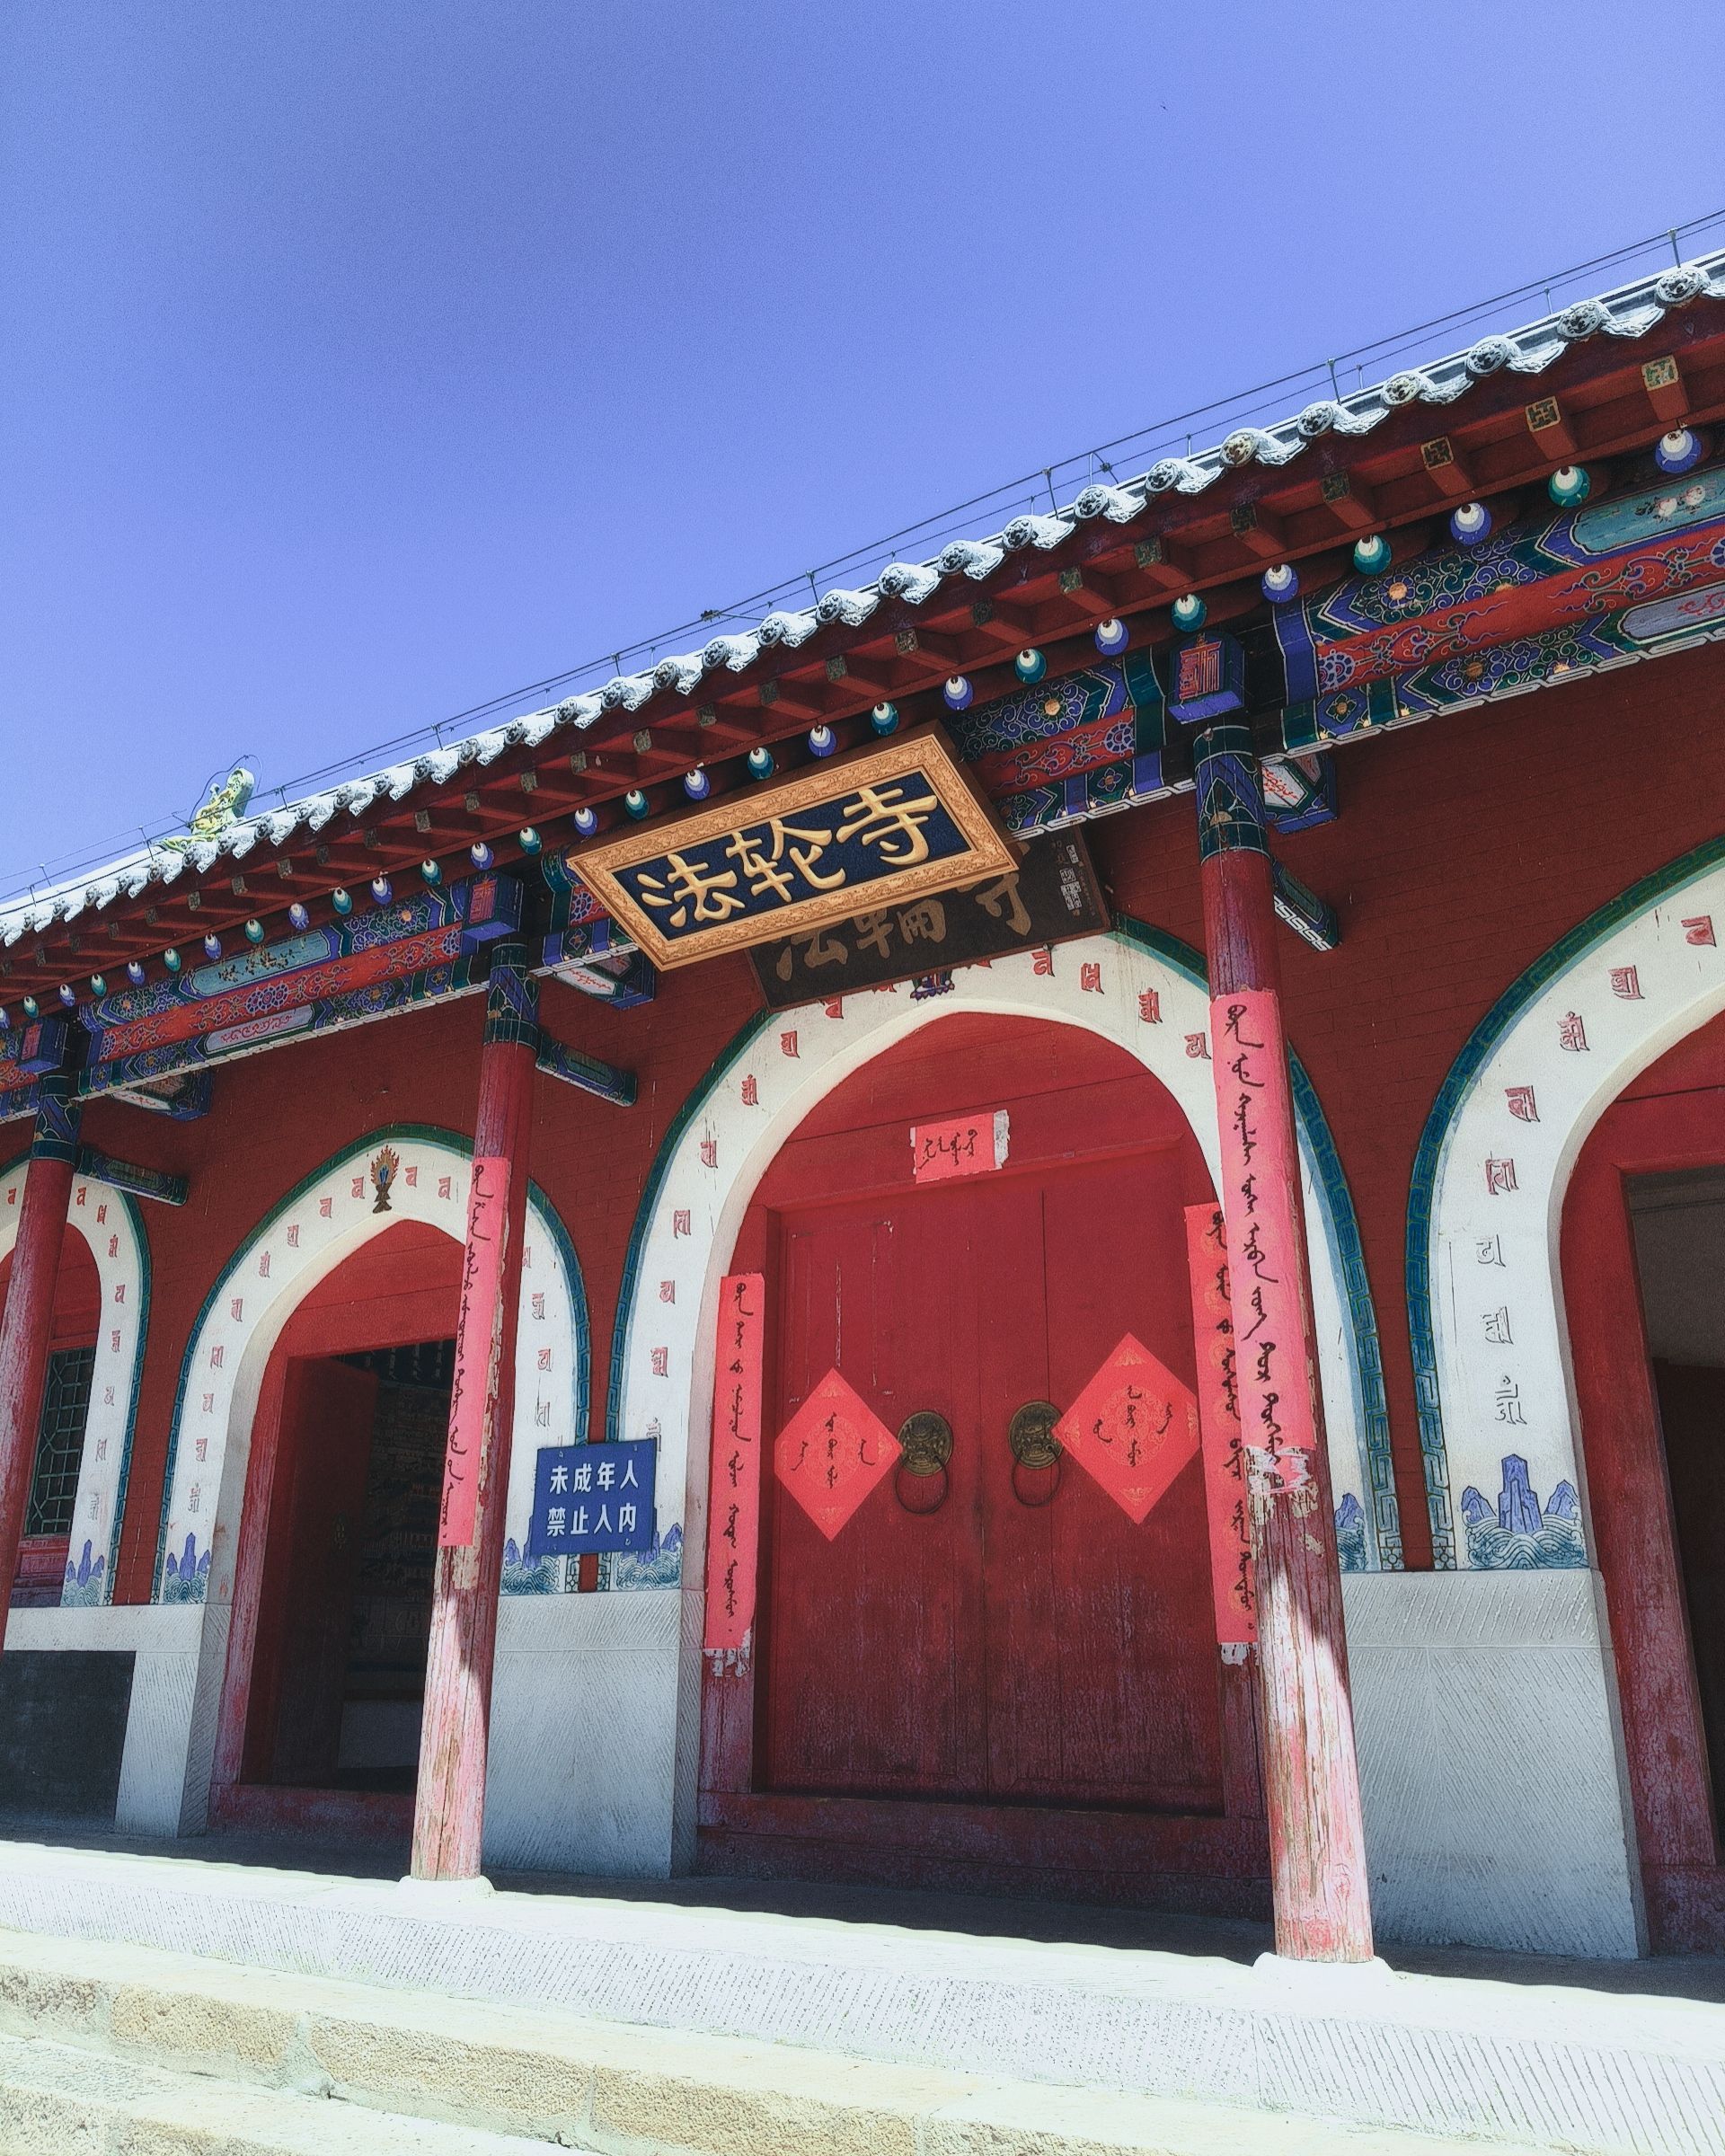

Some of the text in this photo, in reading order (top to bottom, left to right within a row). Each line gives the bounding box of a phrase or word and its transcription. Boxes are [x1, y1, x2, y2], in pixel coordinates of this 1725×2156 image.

[637, 787, 939, 925] 法轮寺
[549, 1459, 639, 1495] 未成年人
